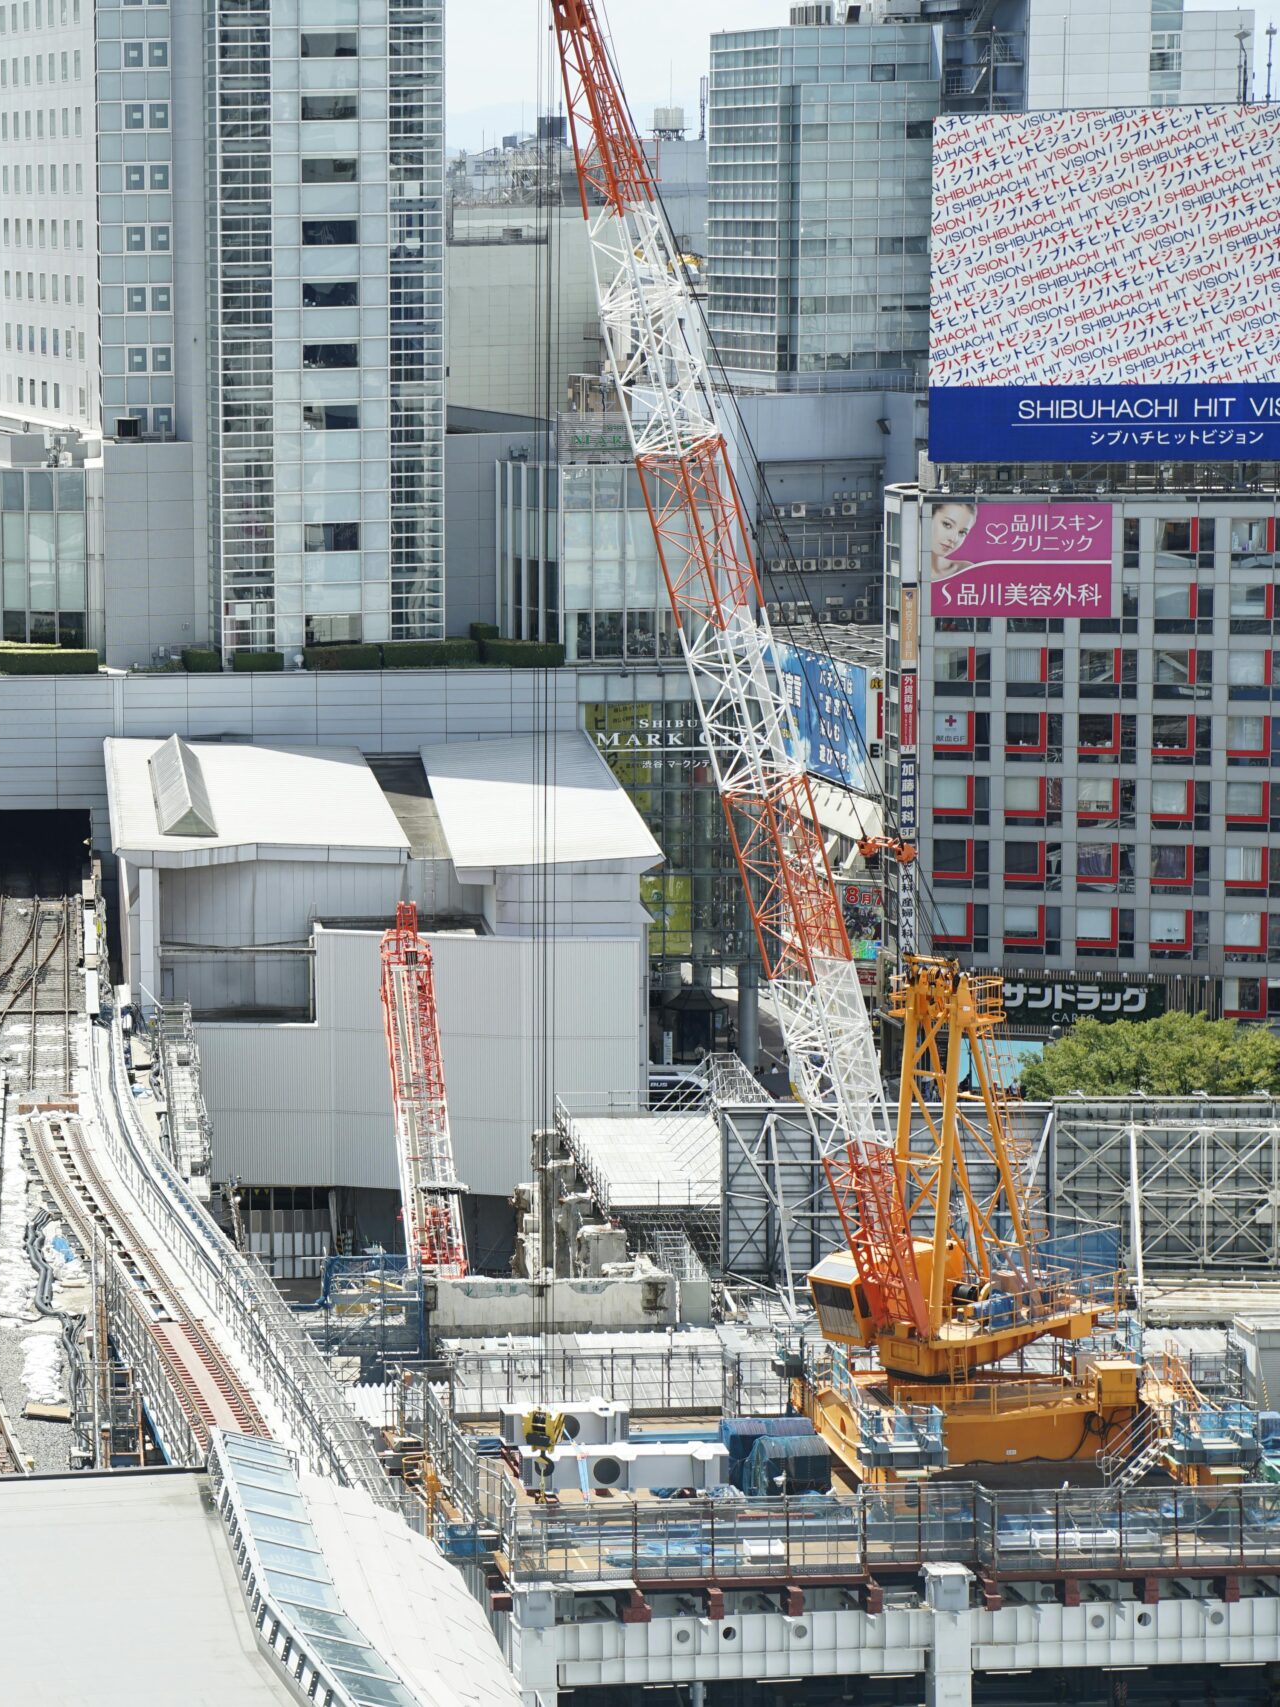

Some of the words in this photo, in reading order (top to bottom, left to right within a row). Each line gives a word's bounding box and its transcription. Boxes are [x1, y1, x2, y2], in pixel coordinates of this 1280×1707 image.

[933, 120, 1065, 173] シブハチヒットビジョン
[951, 127, 1082, 186] シブハチヒットビジョン
[975, 118, 994, 134] HIT
[935, 169, 1013, 205] SHIBUHACHI
[1018, 158, 1037, 174] HIT
[1044, 139, 1089, 163] VISION
[939, 223, 983, 246] VISION
[994, 168, 1126, 226] シブハチヒットビジョン
[1137, 132, 1219, 171] SHIBUHACHI
[952, 176, 1030, 214] SHIBUHACHI
[1061, 147, 1106, 171] VISION
[977, 160, 1109, 218] シブハチヒットビジョン
[1120, 124, 1201, 163] SHIBUHACHI
[1206, 113, 1227, 130] HIT
[939, 273, 959, 289] HIT
[965, 255, 1009, 278] VISION
[1020, 200, 1153, 258] シブハチヒットビジョン
[1164, 165, 1246, 204] SHIBUHACHI
[956, 281, 976, 297] HIT
[982, 263, 1026, 286] VISION
[1037, 208, 1170, 266] シブハチヒットビジョン
[1181, 173, 1264, 211] SHIBUHACHI
[978, 209, 1056, 246] SHIBUHACHI
[1061, 198, 1081, 214] HIT
[1087, 179, 1133, 203] VISION
[995, 217, 1074, 254] SHIBUHACHI
[1105, 187, 1150, 211] VISION
[1008, 295, 1052, 318] VISION
[1063, 241, 1197, 298] シブハチヒットビジョン
[1020, 249, 1100, 286] SHIBUHACHI
[1131, 220, 1177, 244] VISION
[1038, 257, 1117, 294] SHIBUHACHI
[1122, 246, 1142, 262] HIT
[1149, 228, 1195, 251] VISION
[999, 321, 1018, 337] HIT
[1025, 303, 1069, 326] VISION
[1080, 249, 1215, 306] シブハチヒットビジョン
[1051, 336, 1095, 359] VISION
[1106, 282, 1242, 339] シブハチヒットビジョン
[1064, 290, 1144, 326] SHIBUHACHI
[1175, 261, 1221, 284] VISION
[939, 331, 1070, 386] シブハチヒットビジョン
[1081, 297, 1161, 334] SHIBUHACHI
[1166, 287, 1186, 303] HIT
[1193, 268, 1239, 292] VISION
[1042, 361, 1061, 377] HIT
[1068, 344, 1113, 366] VISION
[1124, 289, 1259, 347] シブハチヒットビジョン
[1107, 330, 1188, 367] SHIBUHACHI
[1220, 302, 1266, 325] VISION
[1125, 338, 1205, 375] SHIBUHACHI
[1211, 327, 1231, 343] HIT
[1018, 399, 1178, 419] SHIBUHACHI
[1194, 398, 1236, 417] HIT
[1254, 368, 1276, 386] HIT
[1090, 429, 1264, 446] シブハチヒットビジョン
[1011, 514, 1103, 532] 品川スキン
[1011, 535, 1093, 552] クリニック
[957, 583, 1102, 607] 品川美容外科
[904, 677, 913, 713] 外貨両替
[597, 732, 684, 746] MARK
[642, 760, 663, 769] 渋谷
[901, 762, 915, 825] 加藤眼科
[902, 828, 913, 836] 5F
[1002, 983, 1148, 1012] サンドラッグ
